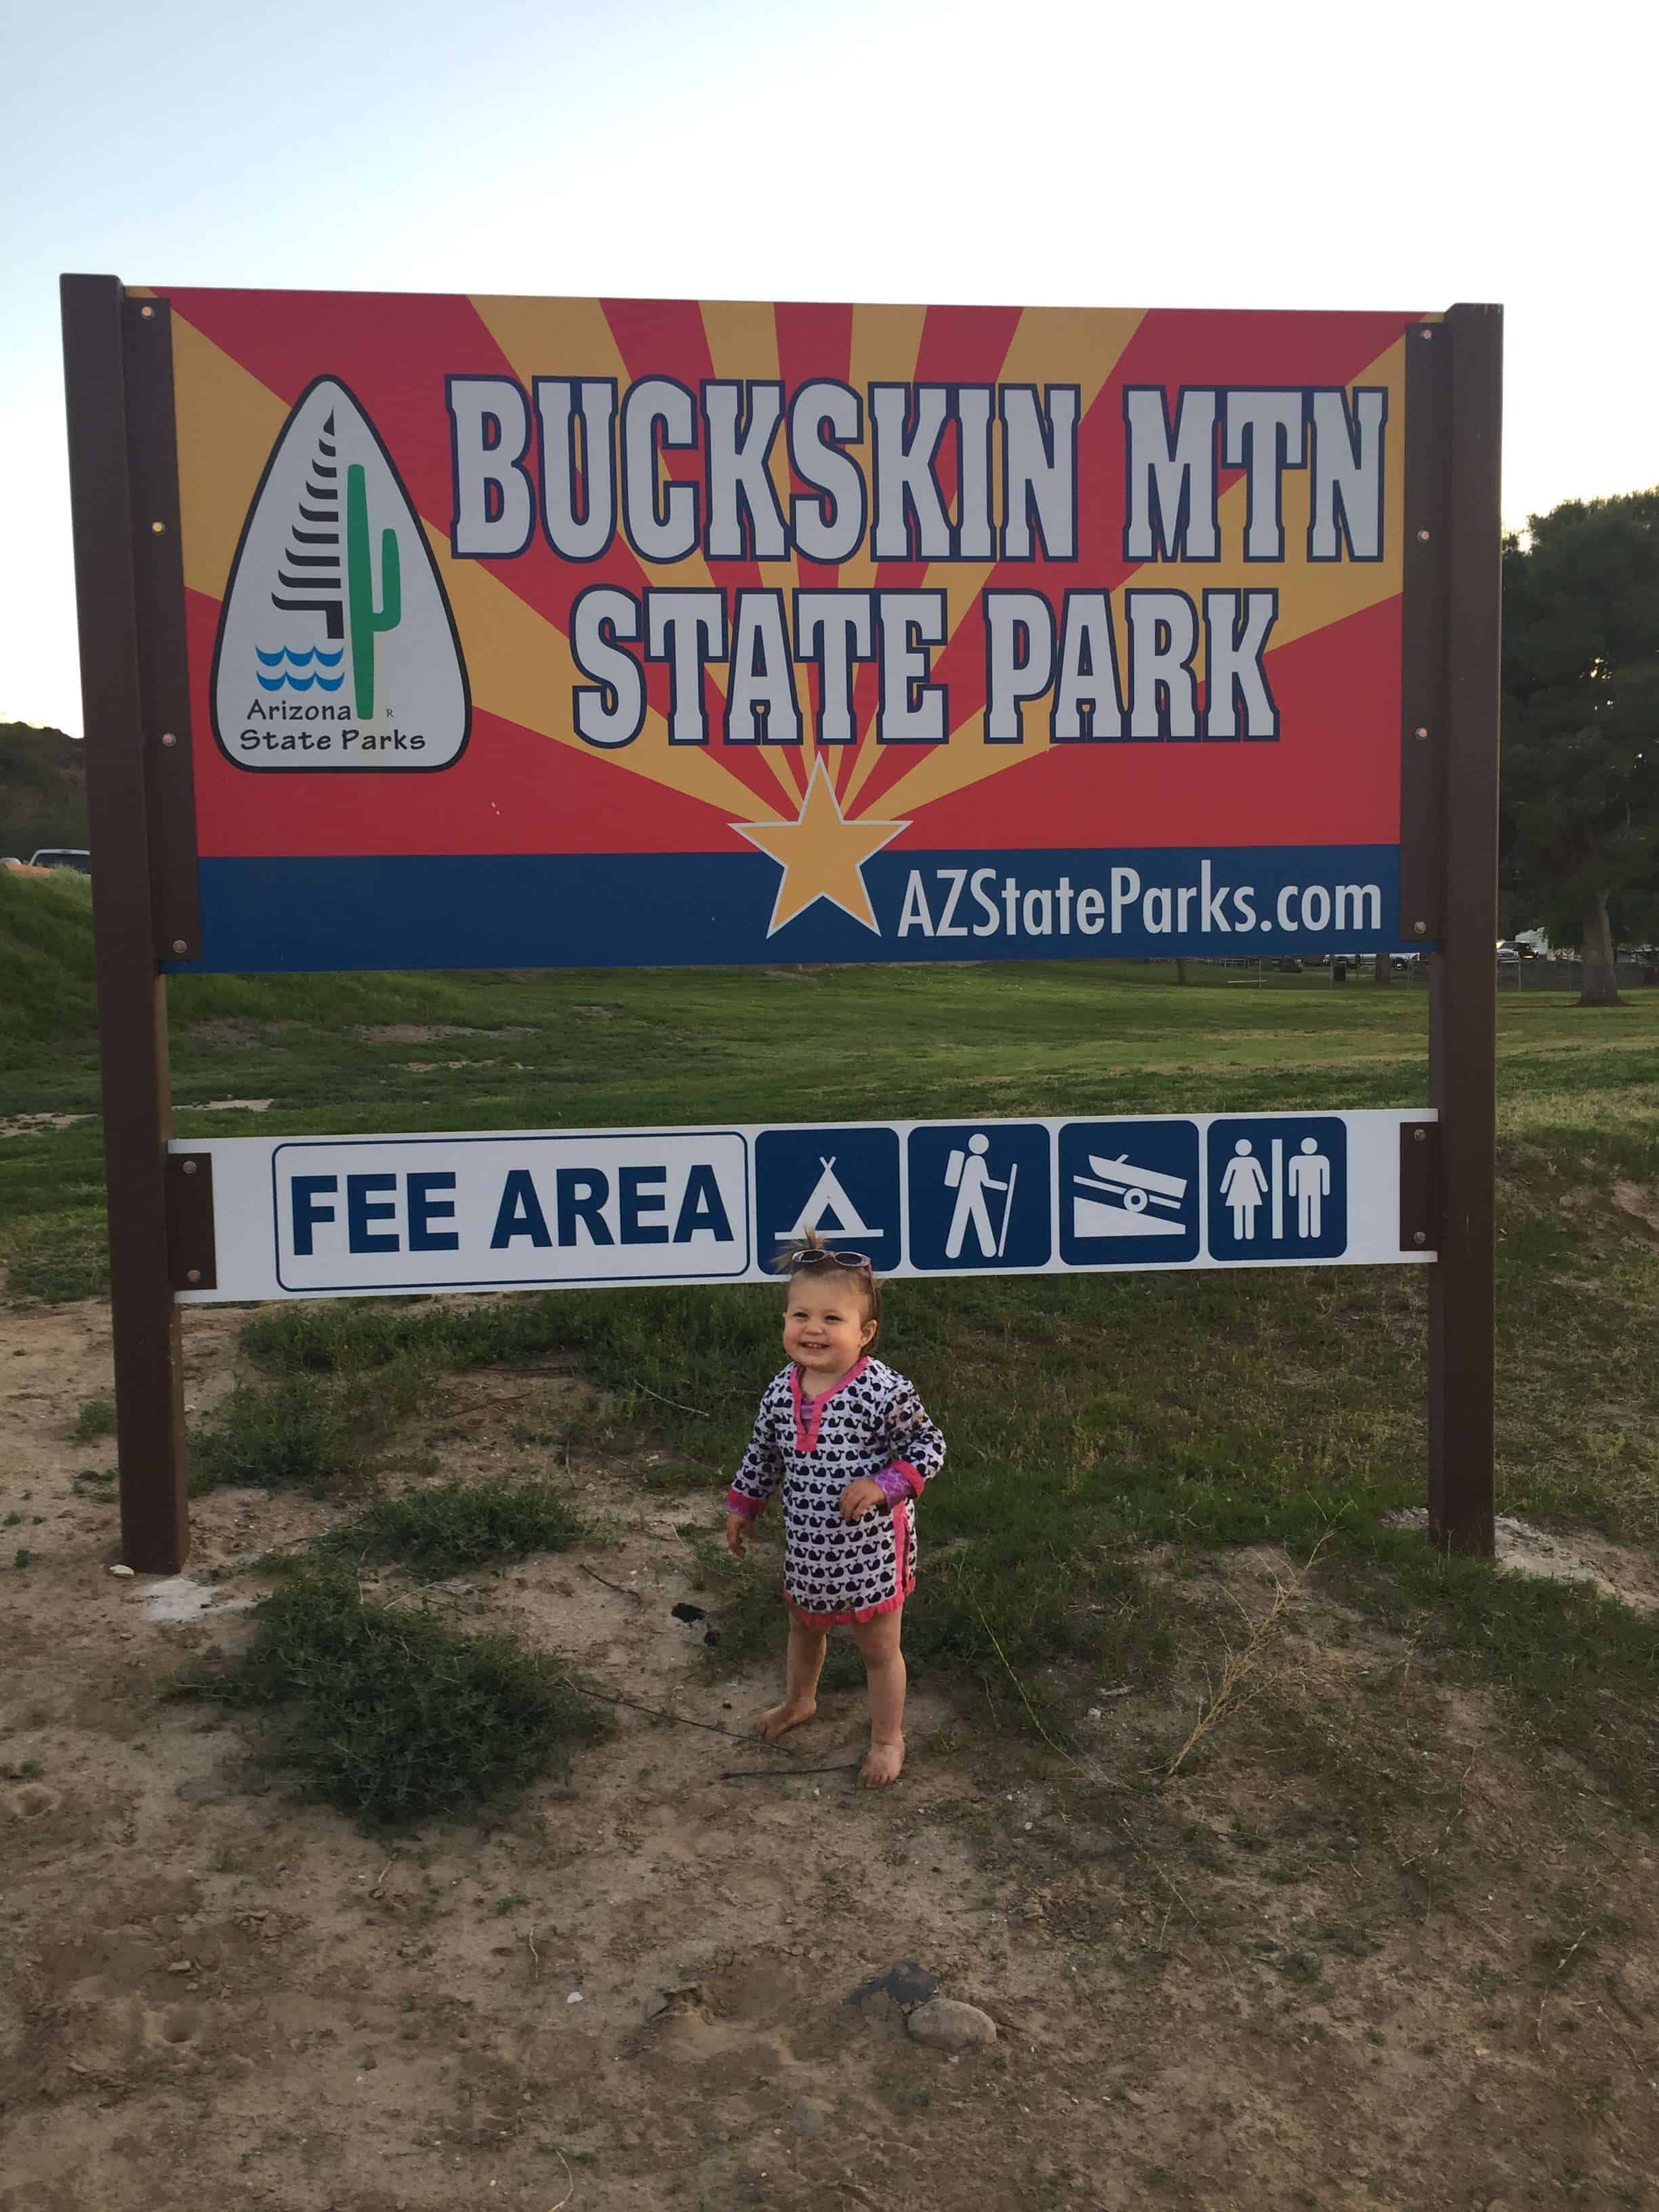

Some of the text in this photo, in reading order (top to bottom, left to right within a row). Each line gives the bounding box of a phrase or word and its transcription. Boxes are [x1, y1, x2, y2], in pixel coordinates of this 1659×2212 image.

[445, 374, 1388, 565] BUCKSKIN MTN
[569, 583, 1280, 749] STATE PARK
[240, 729, 426, 750] State Parks
[247, 699, 351, 720] Arizona
[897, 859, 1382, 937] AZStateParks.com
[291, 1165, 735, 1256] FEE AREA
